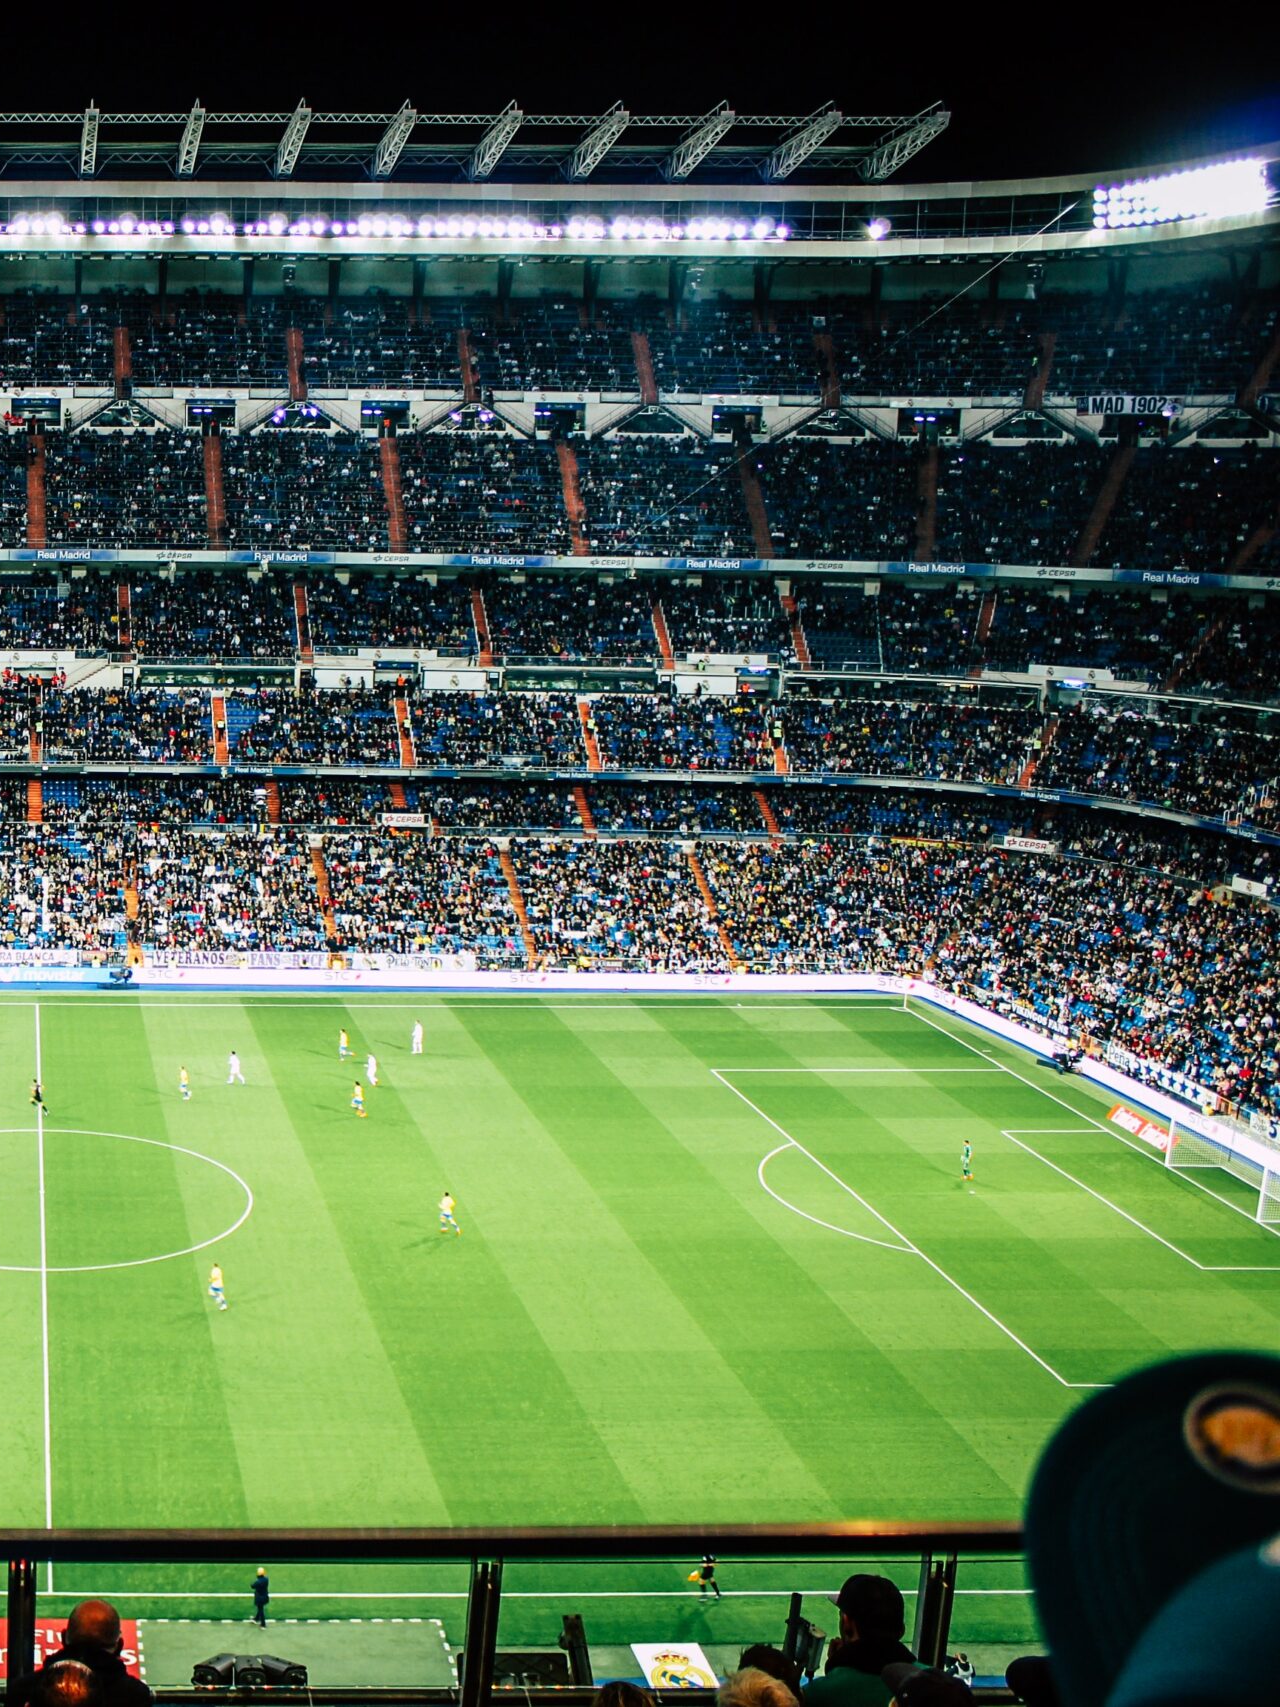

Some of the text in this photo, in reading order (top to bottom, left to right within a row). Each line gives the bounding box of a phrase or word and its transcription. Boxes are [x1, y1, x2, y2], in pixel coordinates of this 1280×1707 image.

[1092, 396, 1167, 414] MAD 1902
[37, 550, 90, 560] Real Madrid
[166, 552, 192, 560] CEPSA
[254, 553, 308, 562] Real Madrid
[471, 556, 524, 565] Real Madrid
[686, 560, 740, 569] Real Madrid
[817, 562, 844, 570] CEPSA
[908, 564, 965, 573] Real Madrid
[1143, 572, 1200, 584] Real Madrid
[1018, 840, 1047, 850] CEPSA
[16, 952, 54, 960] BLANCA
[156, 951, 325, 966] VETERANOS FANS RMCF
[24, 970, 84, 981] movistar
[1048, 1019, 1068, 1036] FANS
[1108, 1046, 1130, 1066] Peña
